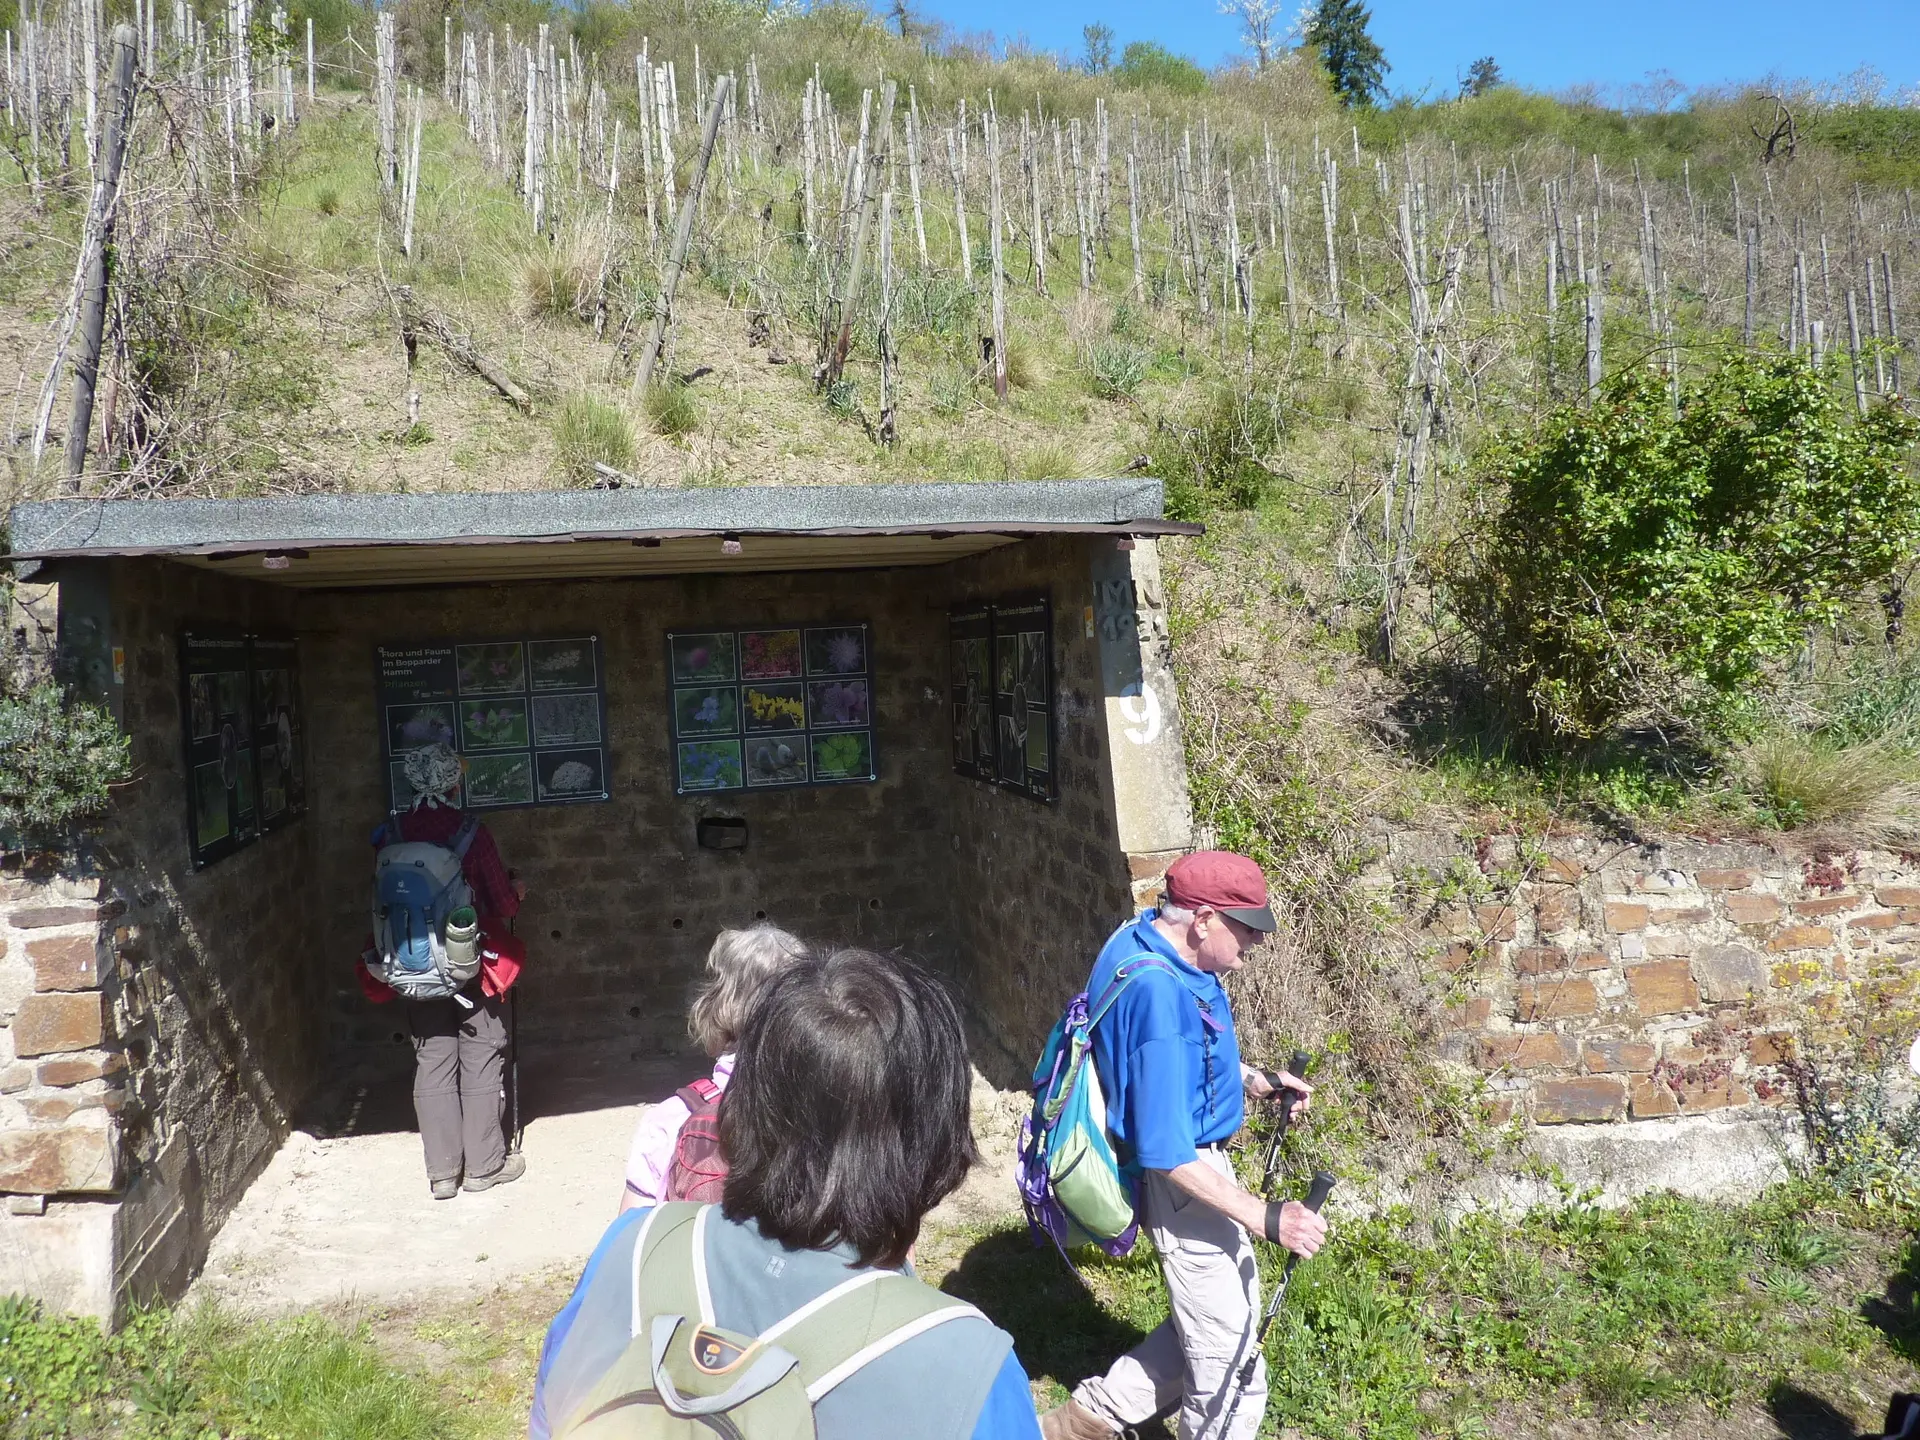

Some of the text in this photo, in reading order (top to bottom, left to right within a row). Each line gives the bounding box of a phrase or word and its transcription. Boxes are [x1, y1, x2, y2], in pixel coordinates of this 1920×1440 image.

[382, 650, 404, 658] Flora
[424, 648, 451, 656] Fauna
[395, 658, 442, 667] Bopparder
[1119, 682, 1161, 745] 9
